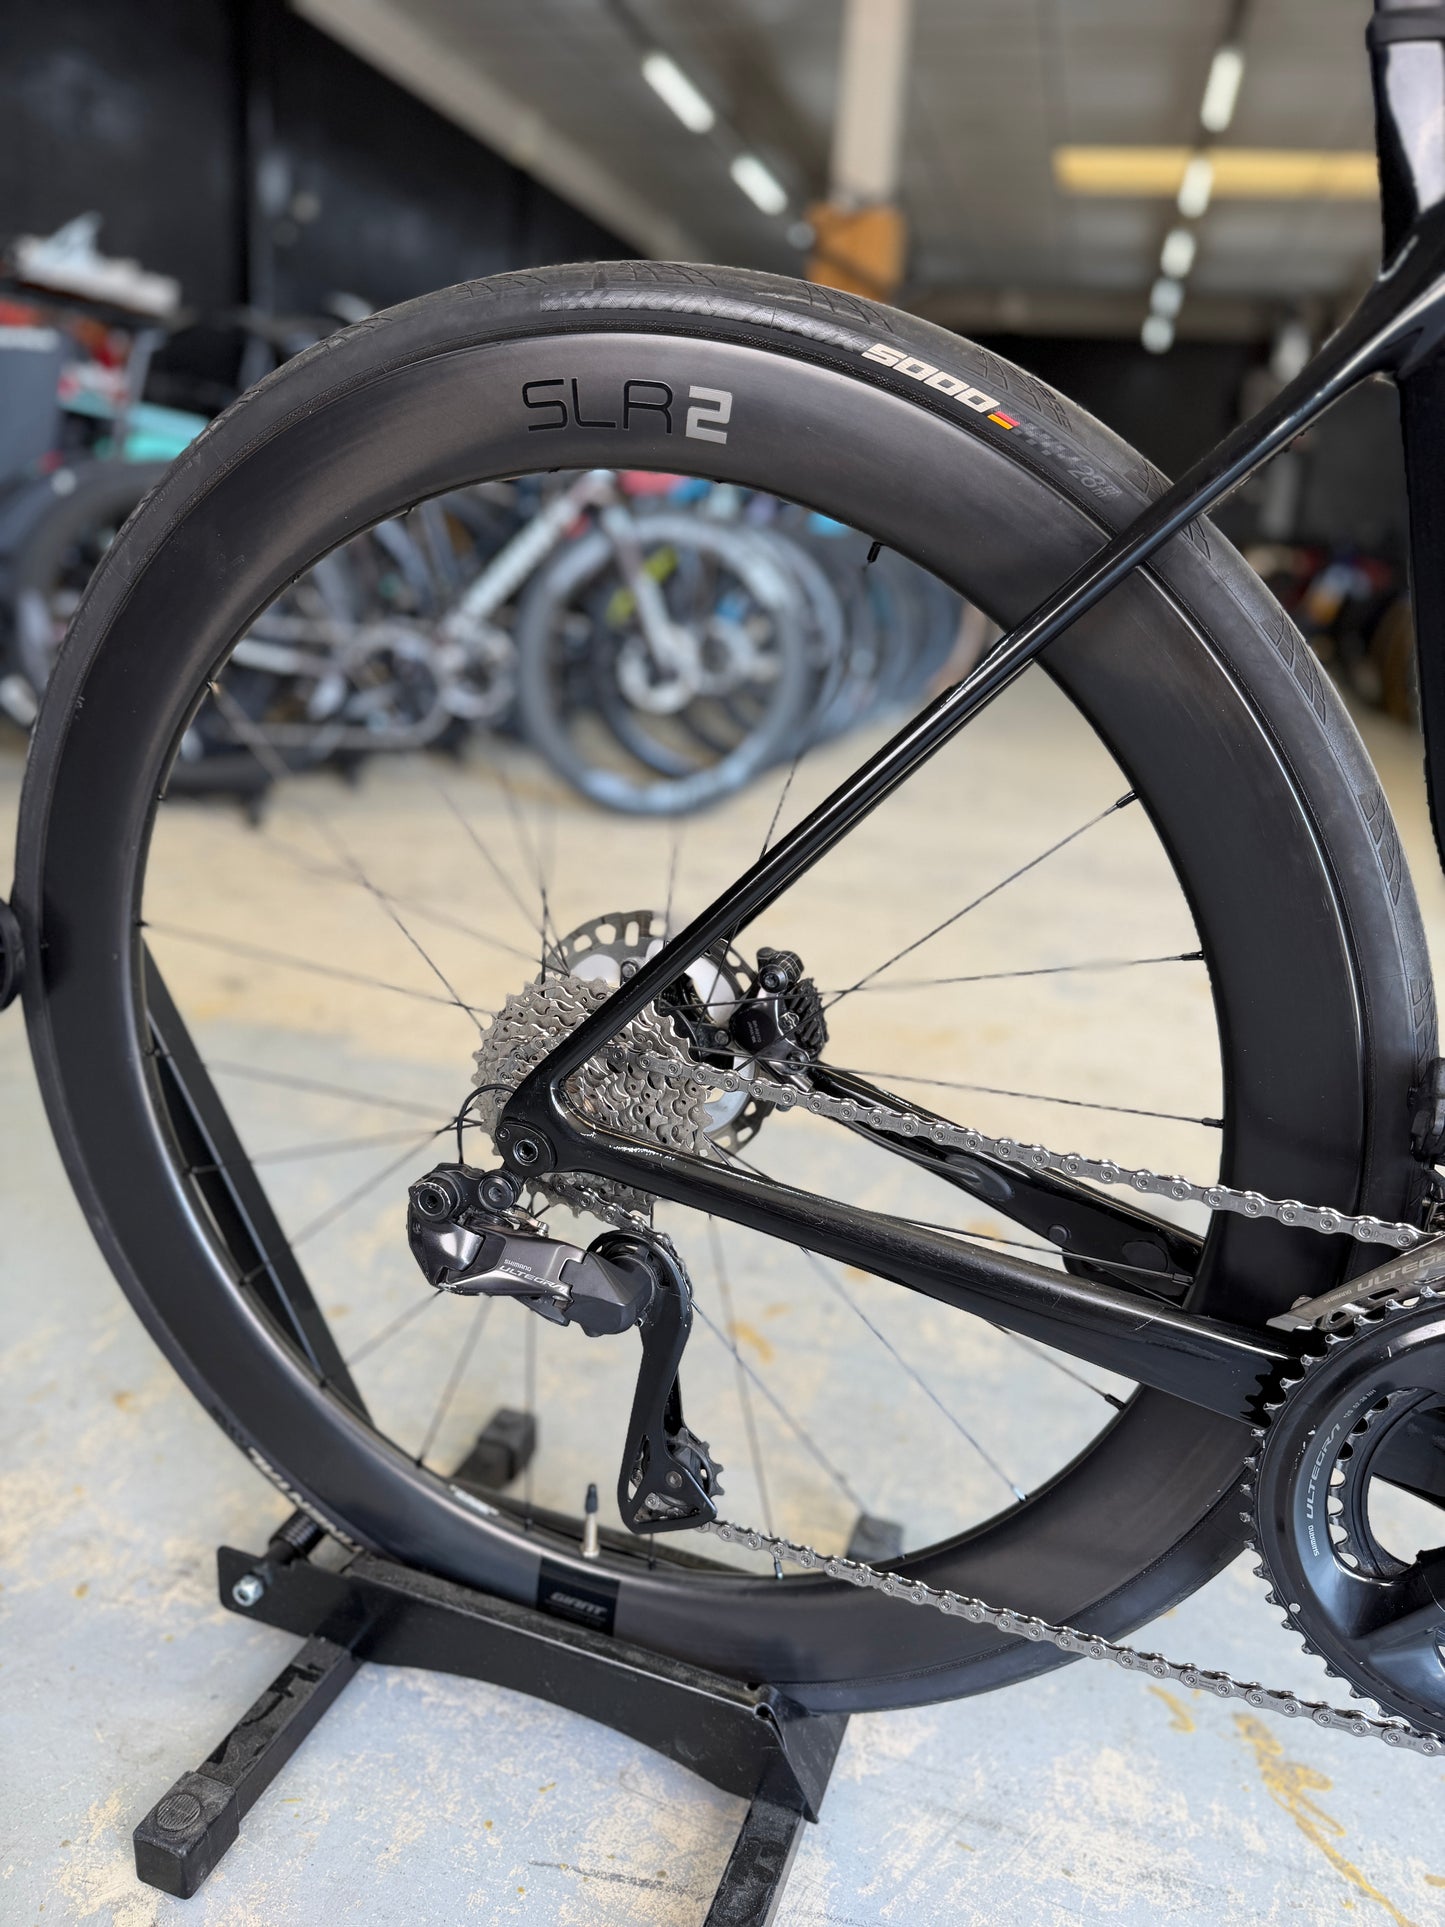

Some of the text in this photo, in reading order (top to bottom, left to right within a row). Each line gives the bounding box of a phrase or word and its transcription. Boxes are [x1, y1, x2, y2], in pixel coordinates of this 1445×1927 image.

[861, 343, 1001, 413] 5000
[499, 1265, 569, 1295] ULTEGRA
[503, 1259, 532, 1272] SHIMANO
[1306, 1423, 1341, 1519] ULTEGRA
[1307, 1524, 1320, 1557] SHIMANO
